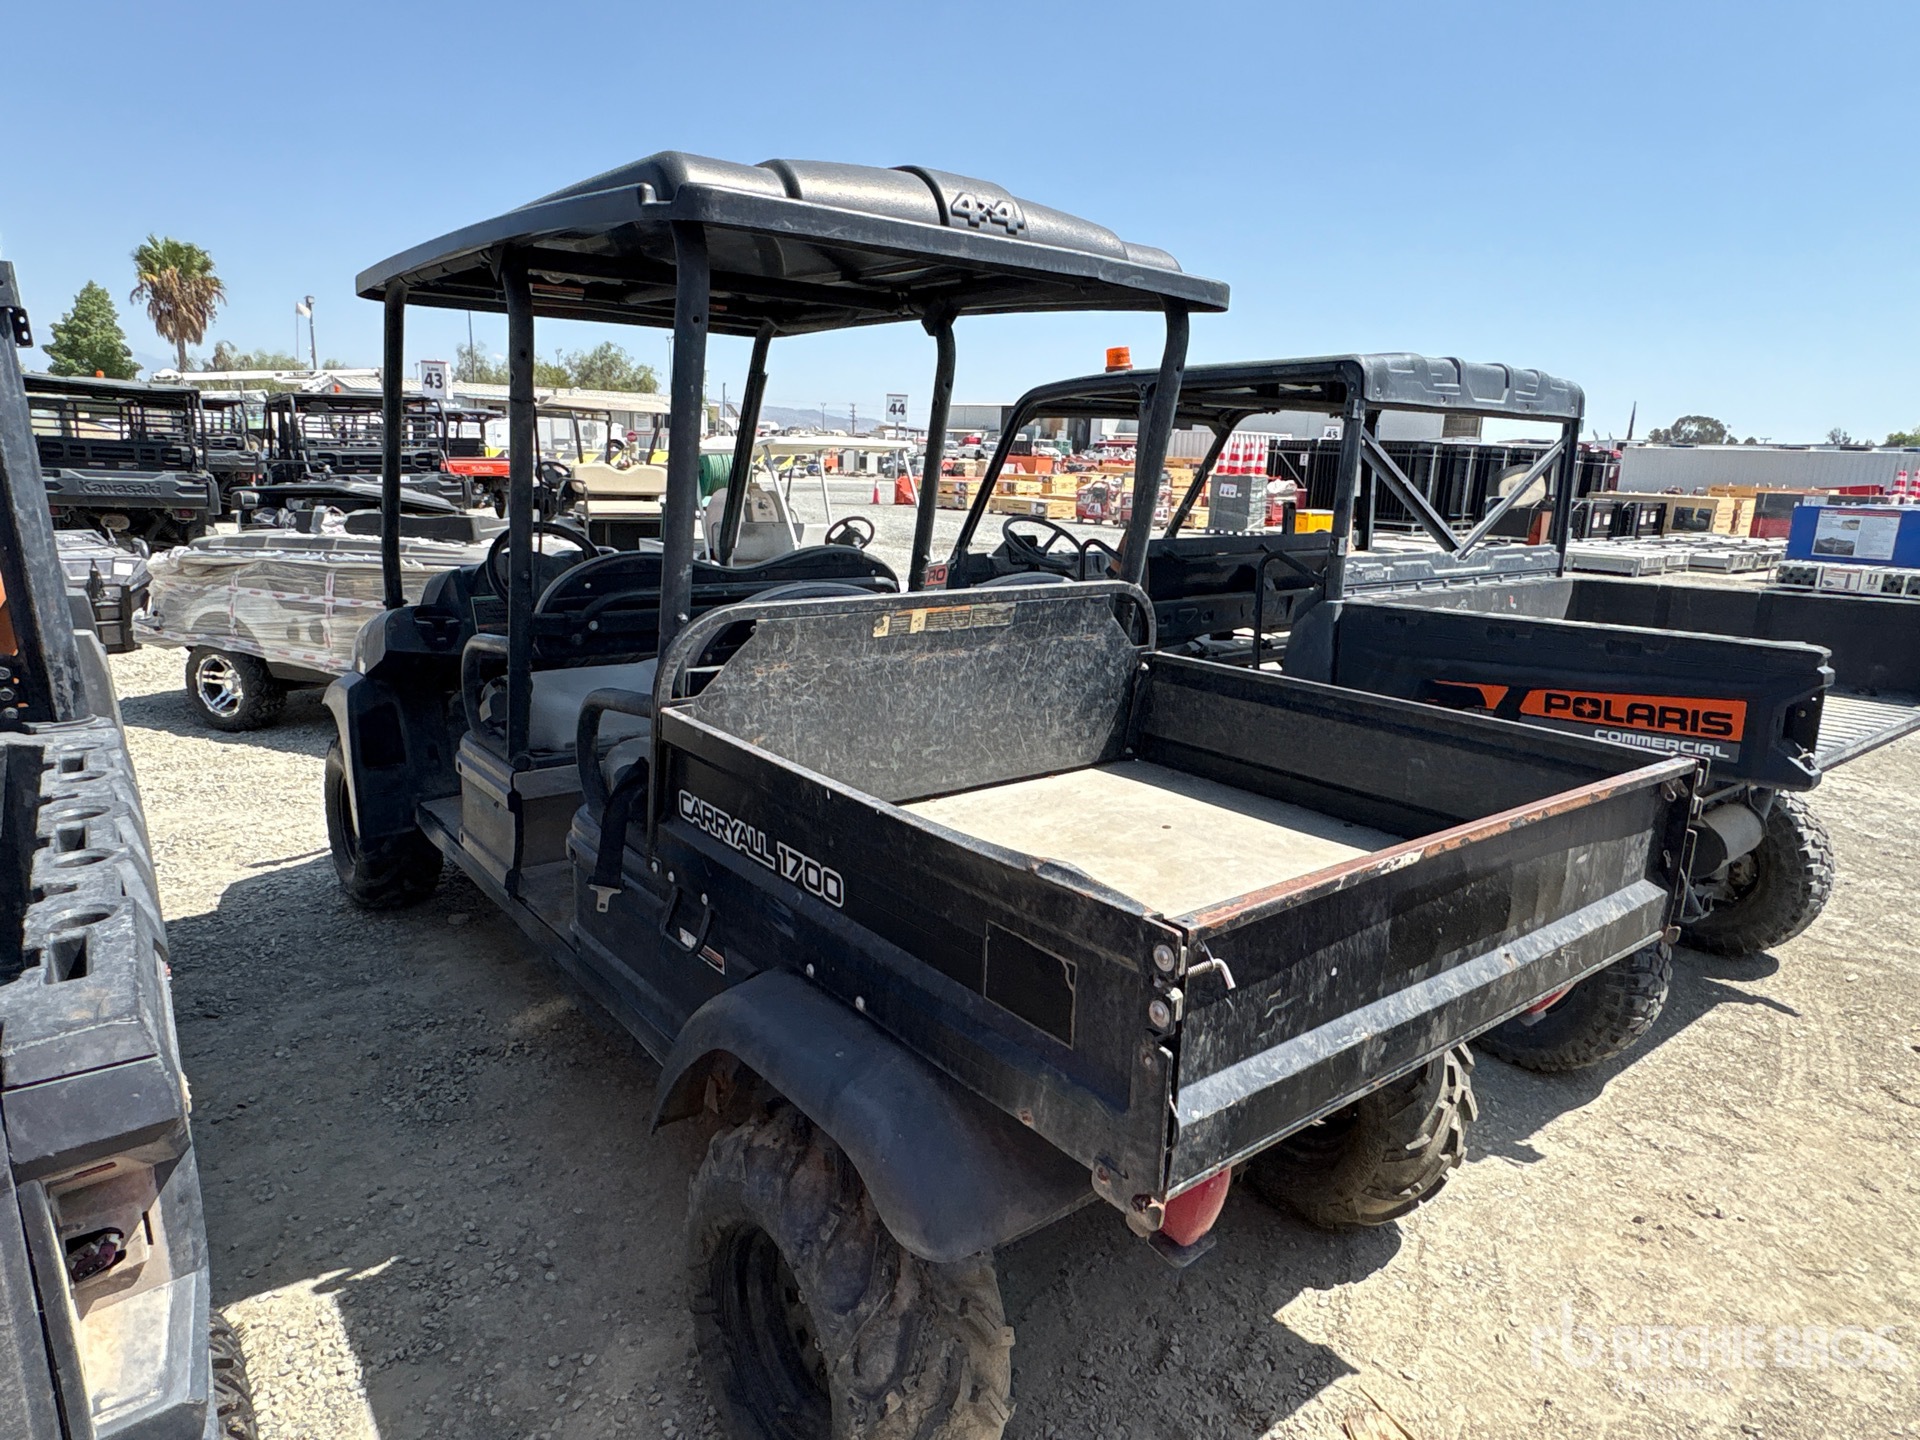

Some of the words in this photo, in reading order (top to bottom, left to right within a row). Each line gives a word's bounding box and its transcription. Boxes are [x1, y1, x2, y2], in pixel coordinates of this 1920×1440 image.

[424, 372, 443, 389] 43
[889, 403, 906, 416] 44
[1326, 430, 1338, 439] 45
[78, 480, 161, 496] Kawasaki
[1544, 692, 1733, 736] POLARIS
[1594, 729, 1730, 759] COMMERCIAL
[678, 789, 776, 870] CARRYALL
[776, 840, 845, 908] 1700
